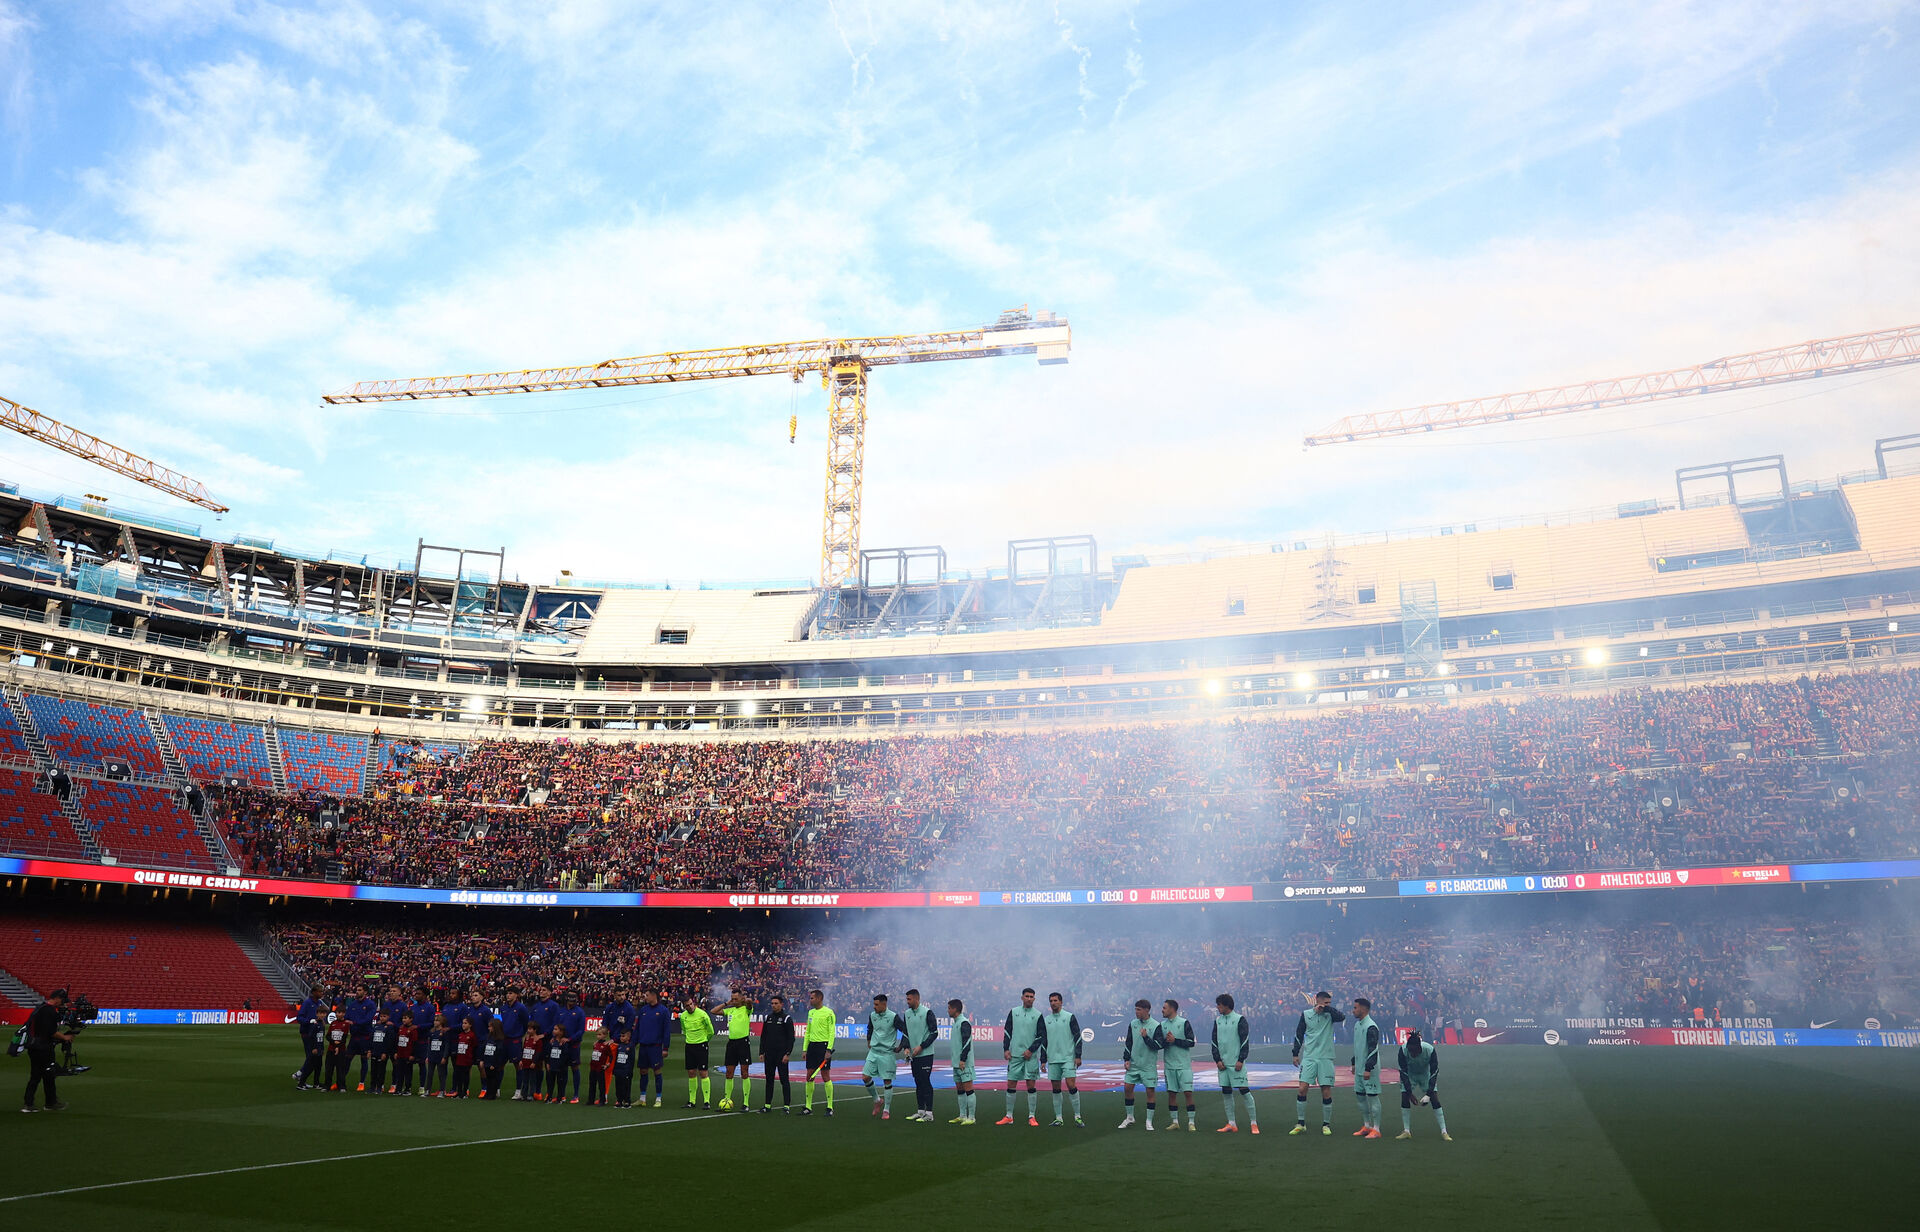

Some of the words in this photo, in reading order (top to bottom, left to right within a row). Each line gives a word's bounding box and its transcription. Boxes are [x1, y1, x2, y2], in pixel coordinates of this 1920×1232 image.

[134, 870, 165, 884] QUE
[168, 873, 202, 886] HEM
[205, 877, 259, 890] CRIDAT
[1742, 869, 1779, 878] ESTRELLA
[1440, 880, 1452, 893] FC
[1453, 878, 1508, 892] BARCELONA
[1525, 876, 1535, 890] 0
[1541, 876, 1568, 889] 00:00
[1575, 875, 1586, 888] 0
[1600, 873, 1644, 887] ATHLETIC
[1645, 871, 1672, 885] CLUB
[450, 890, 478, 903] SÓN
[480, 893, 524, 904] MOLTS
[526, 894, 558, 905] GOLS
[1014, 892, 1025, 903] FC
[1026, 891, 1072, 904] BARCELONA
[1087, 890, 1096, 903] 0
[1101, 890, 1124, 902] 00:00
[1129, 889, 1138, 902] 0
[1150, 889, 1188, 901] ATHLETIC
[1188, 888, 1210, 900] CLUB
[1295, 887, 1325, 896] SPOTIFY
[1326, 886, 1348, 895] CAMP
[1349, 886, 1366, 894] NOU
[729, 894, 756, 907] QUE
[758, 894, 789, 905] HEM
[791, 894, 840, 905] CRIDAT
[191, 1011, 228, 1025] TORNEM
[229, 1011, 236, 1025] A
[237, 1011, 260, 1025] CASA
[1744, 1018, 1773, 1029] CASA
[1587, 1038, 1631, 1046] AMBILIGHT
[1671, 1030, 1726, 1046] TORNEM
[1739, 1031, 1776, 1046] CASA
[1878, 1031, 1920, 1048] TORN
